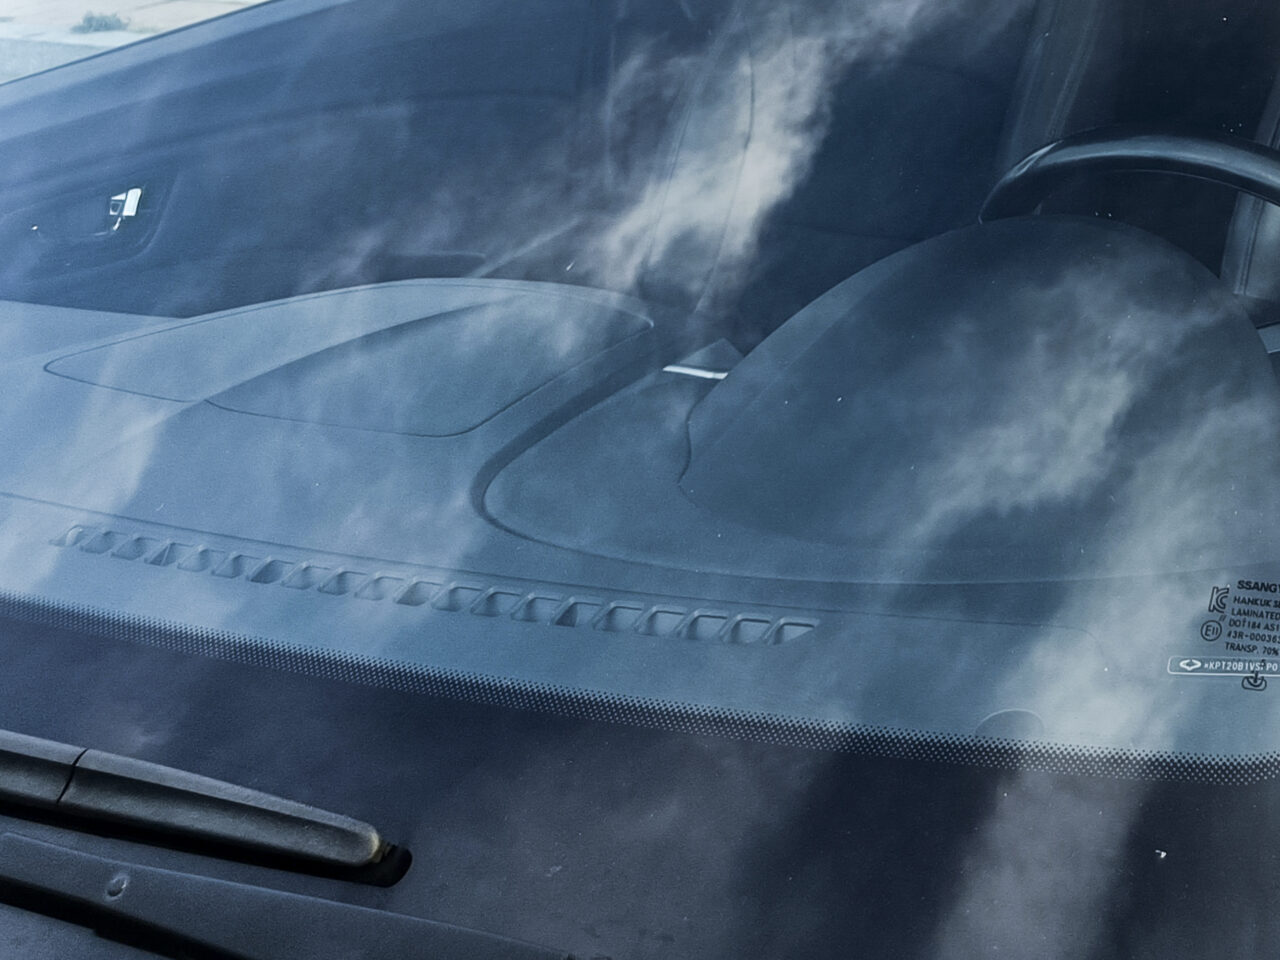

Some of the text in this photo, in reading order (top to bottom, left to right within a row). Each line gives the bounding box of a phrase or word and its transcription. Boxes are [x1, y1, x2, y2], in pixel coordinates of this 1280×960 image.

[1233, 596, 1272, 608] HANKUK
[1231, 608, 1280, 620] LAMINATED
[1262, 646, 1279, 657] 70%
